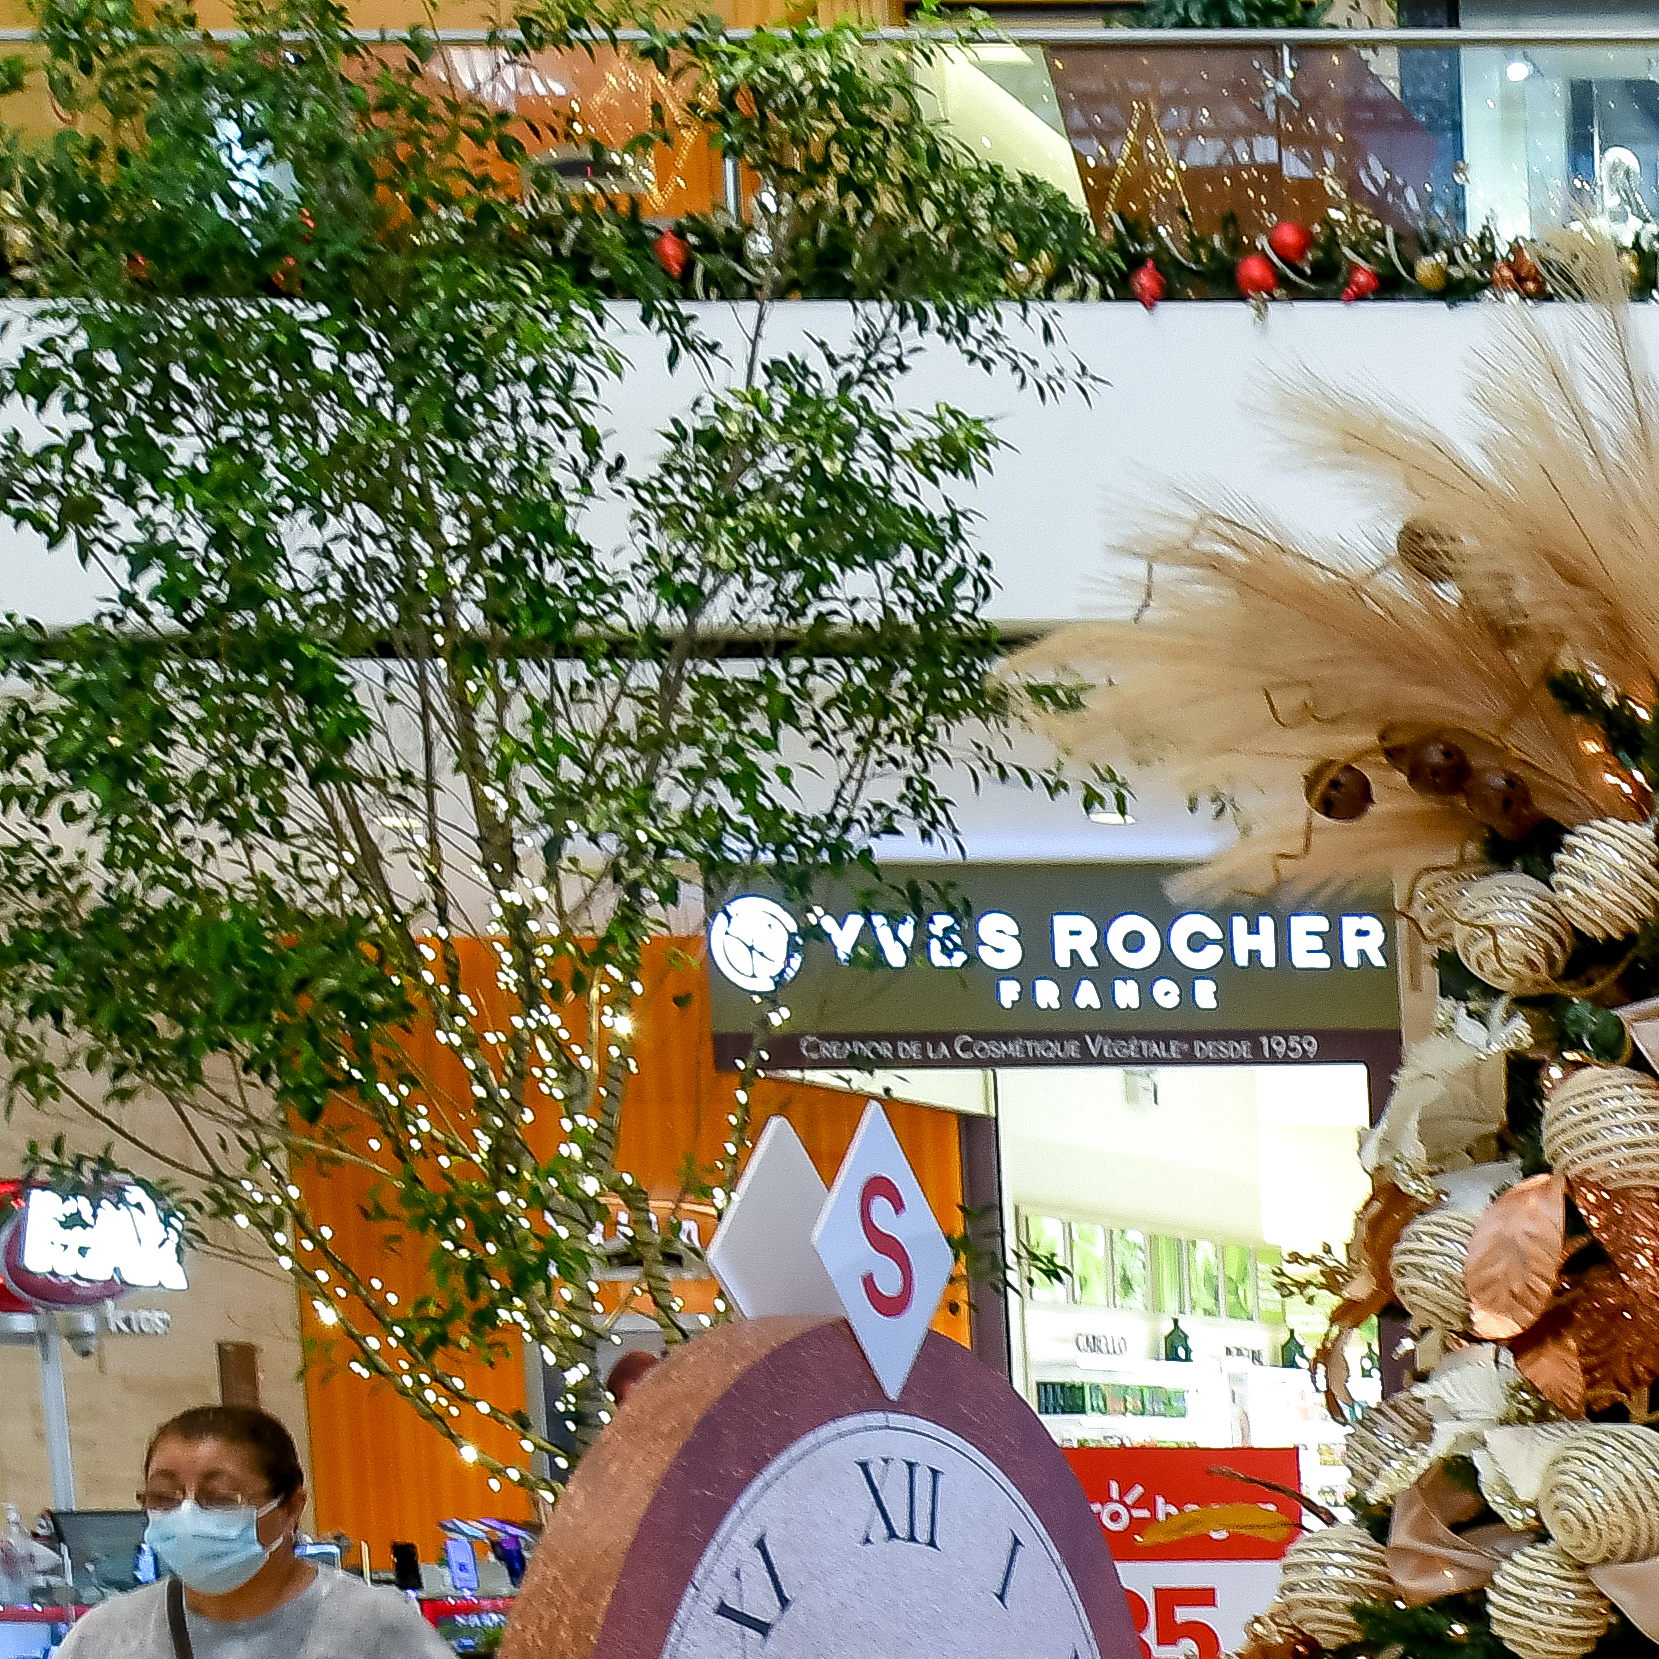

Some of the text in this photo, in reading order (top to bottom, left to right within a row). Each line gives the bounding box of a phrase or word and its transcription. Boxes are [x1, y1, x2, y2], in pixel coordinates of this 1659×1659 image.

[819, 910, 1389, 970] YVES ROCHER
[997, 977, 1220, 1010] FRANCE
[1258, 1034, 1320, 1060] 1959
[859, 1173, 915, 1319] S
[855, 1457, 944, 1551] XII
[993, 1528, 1025, 1609] I
